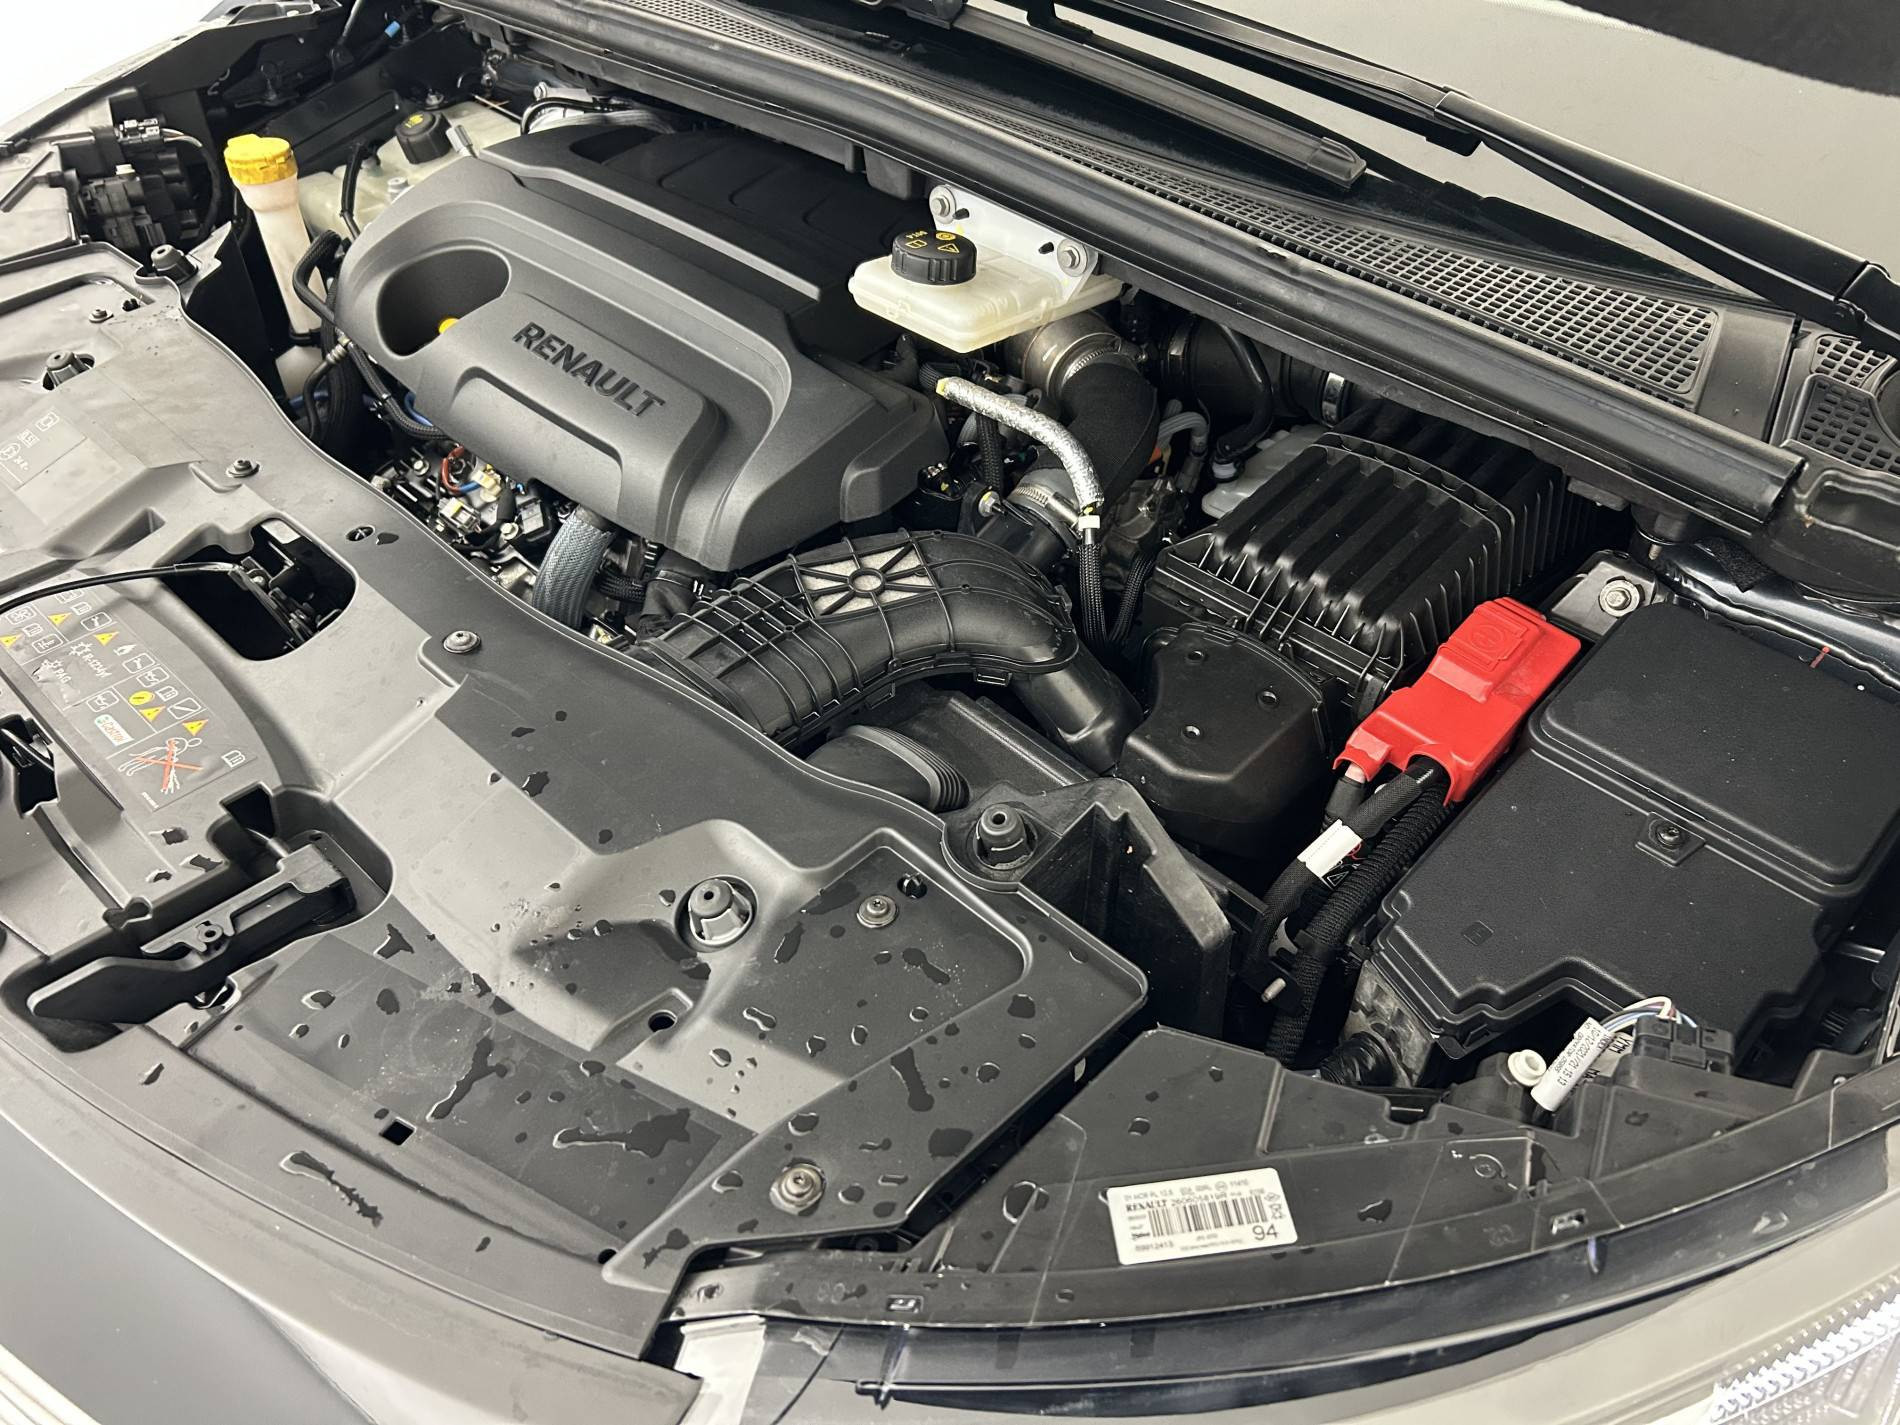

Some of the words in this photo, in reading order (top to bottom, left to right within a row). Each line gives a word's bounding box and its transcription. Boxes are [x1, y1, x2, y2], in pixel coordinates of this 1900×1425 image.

[512, 321, 666, 417] RENAULT
[54, 668, 71, 683] PAG
[1125, 1199, 1167, 1212] RENAULT
[1252, 1224, 1279, 1241] 94
